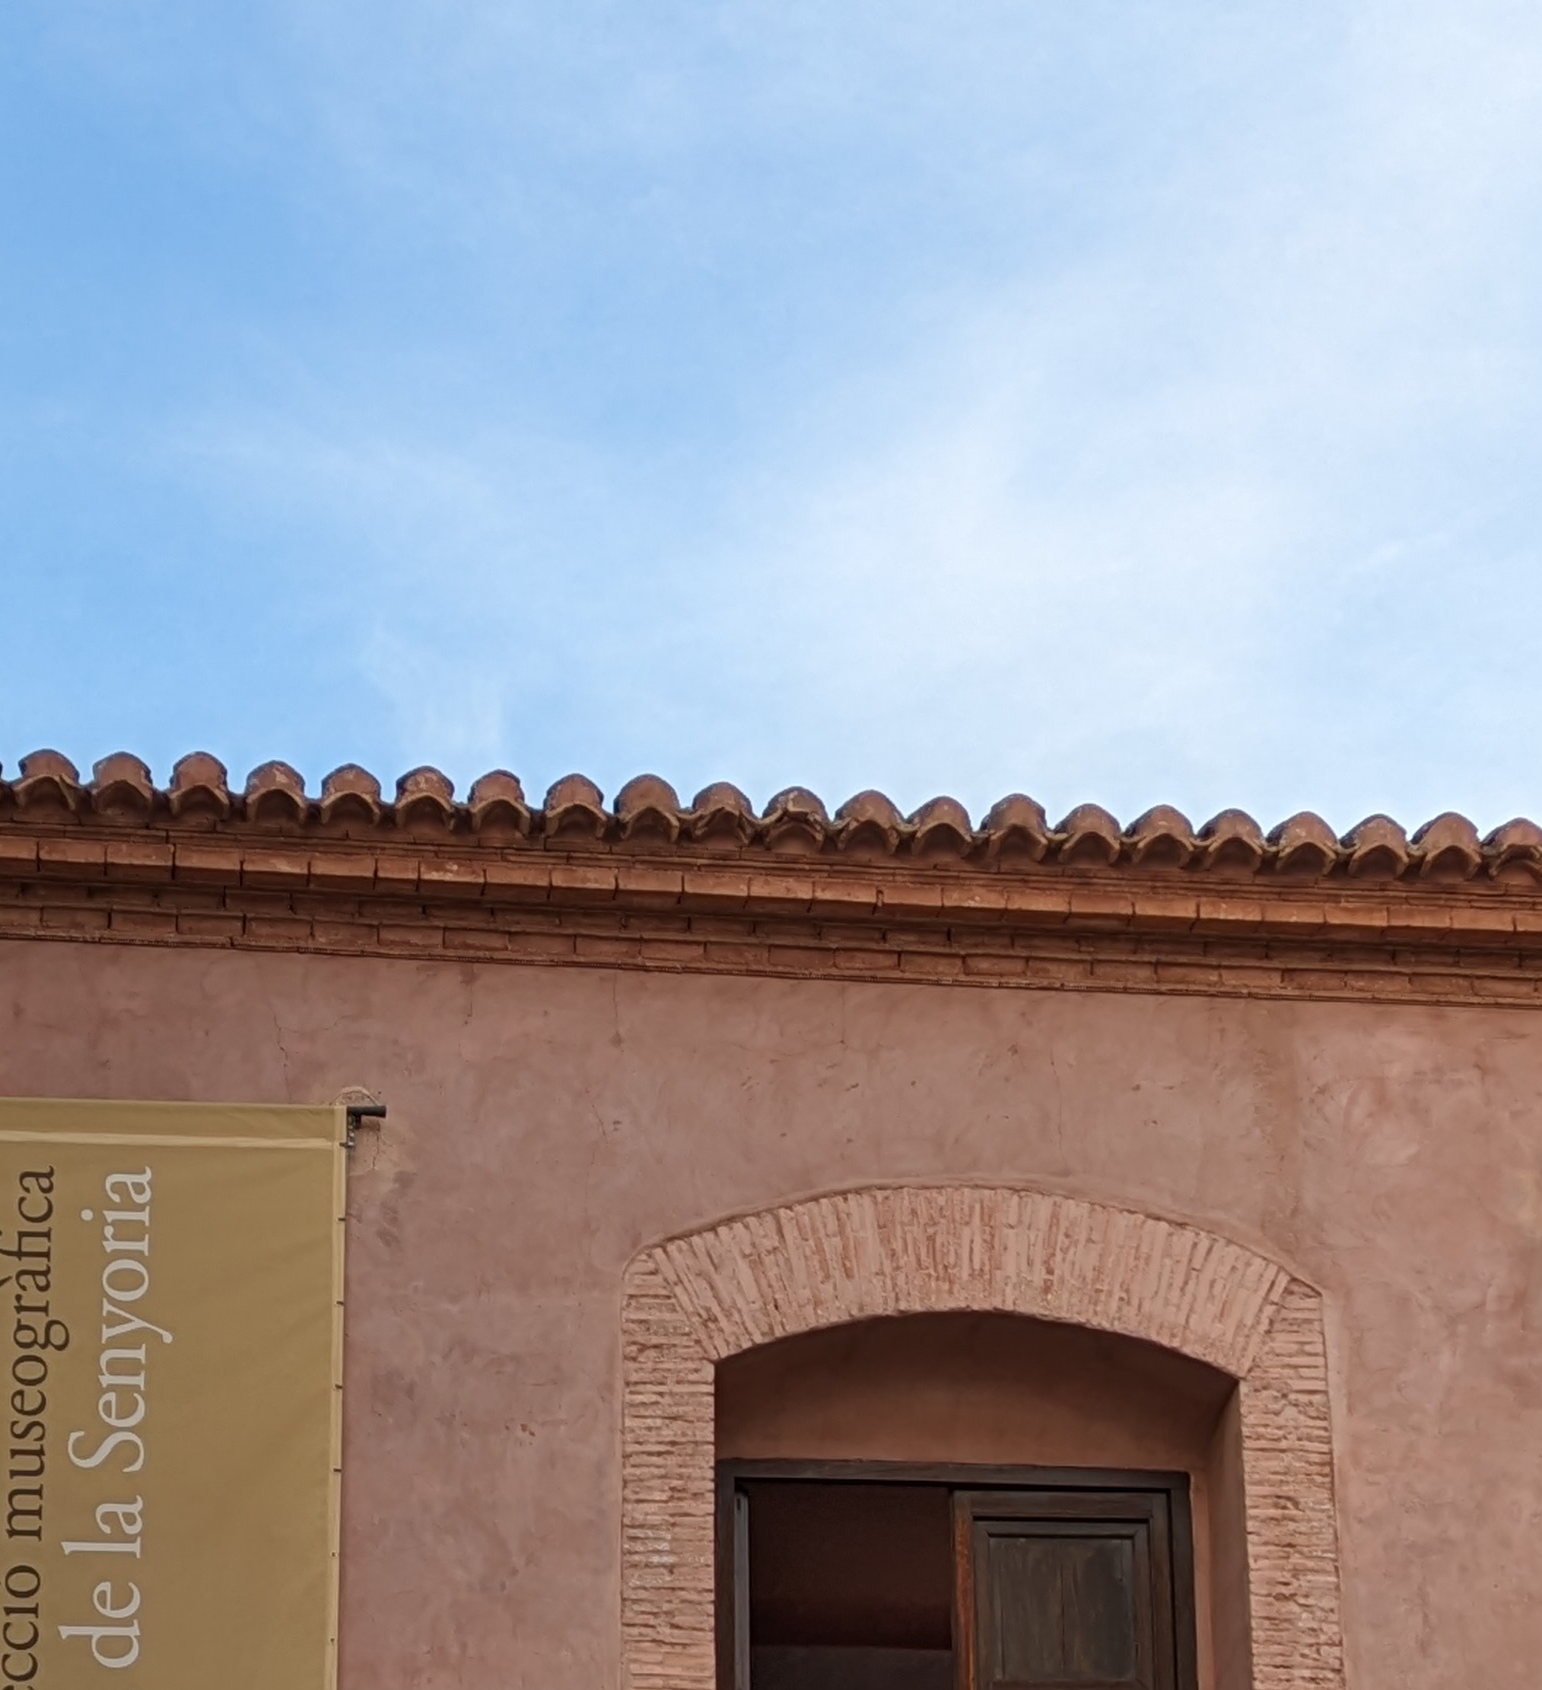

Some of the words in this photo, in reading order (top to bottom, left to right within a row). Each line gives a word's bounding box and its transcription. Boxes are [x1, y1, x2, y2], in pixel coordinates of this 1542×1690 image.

[67, 1165, 174, 1473] Senyoria
[60, 1495, 144, 1559] la
[57, 1581, 141, 1669] de
